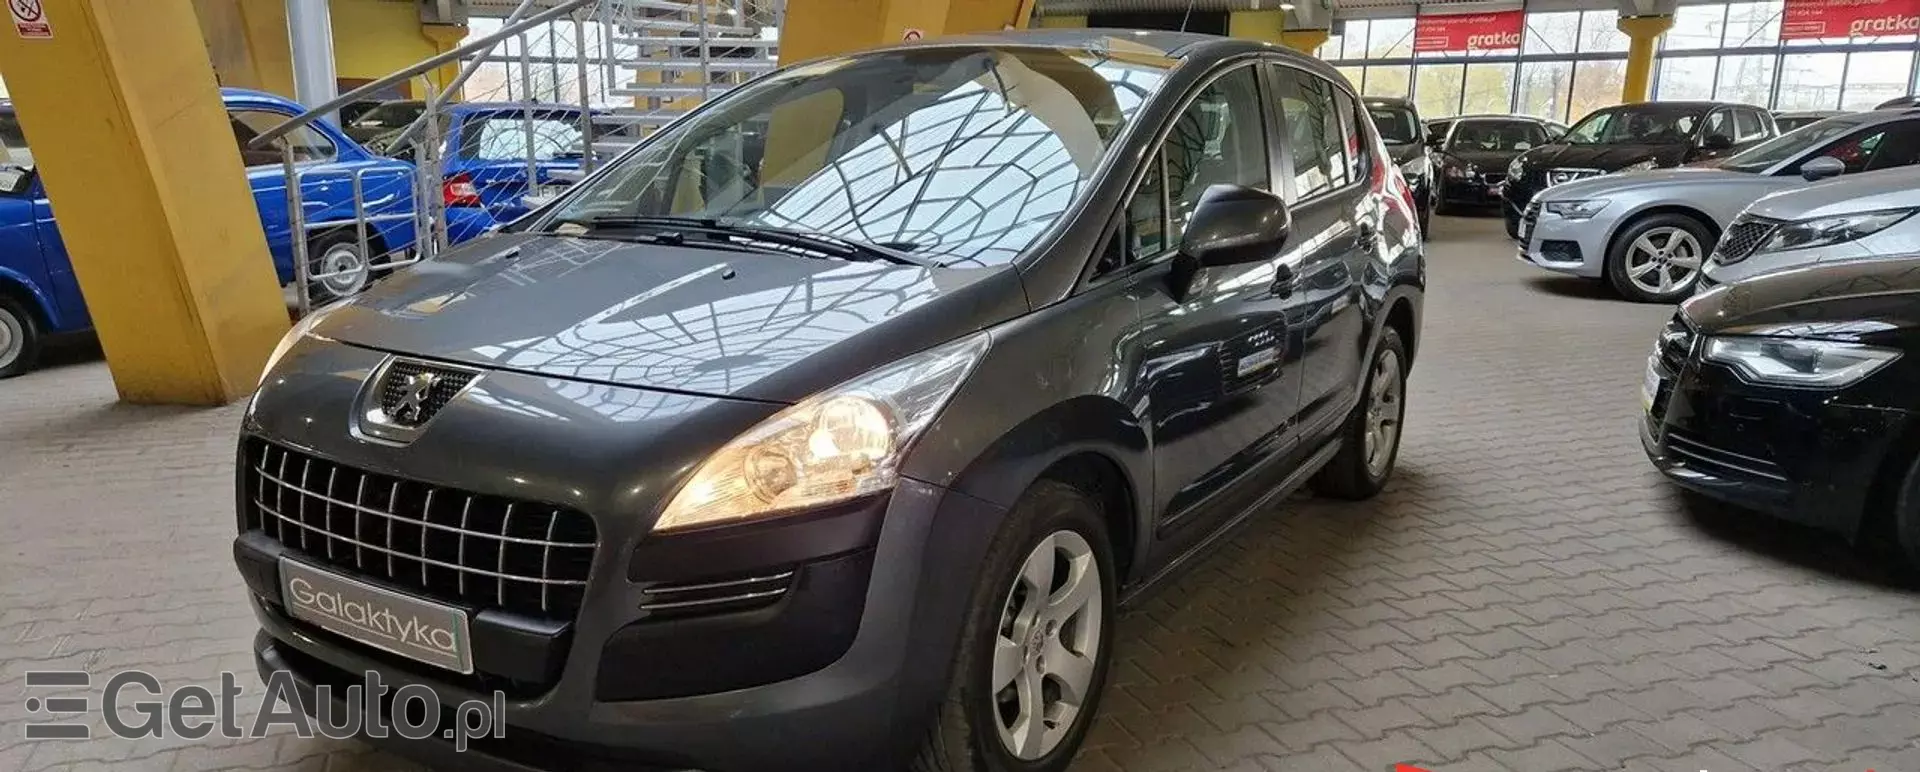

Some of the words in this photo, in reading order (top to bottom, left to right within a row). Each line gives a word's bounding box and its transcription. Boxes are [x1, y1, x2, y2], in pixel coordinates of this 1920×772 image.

[1850, 14, 1919, 37] gratka
[1467, 31, 1519, 50] gratka
[289, 577, 457, 653] Galaktyka
